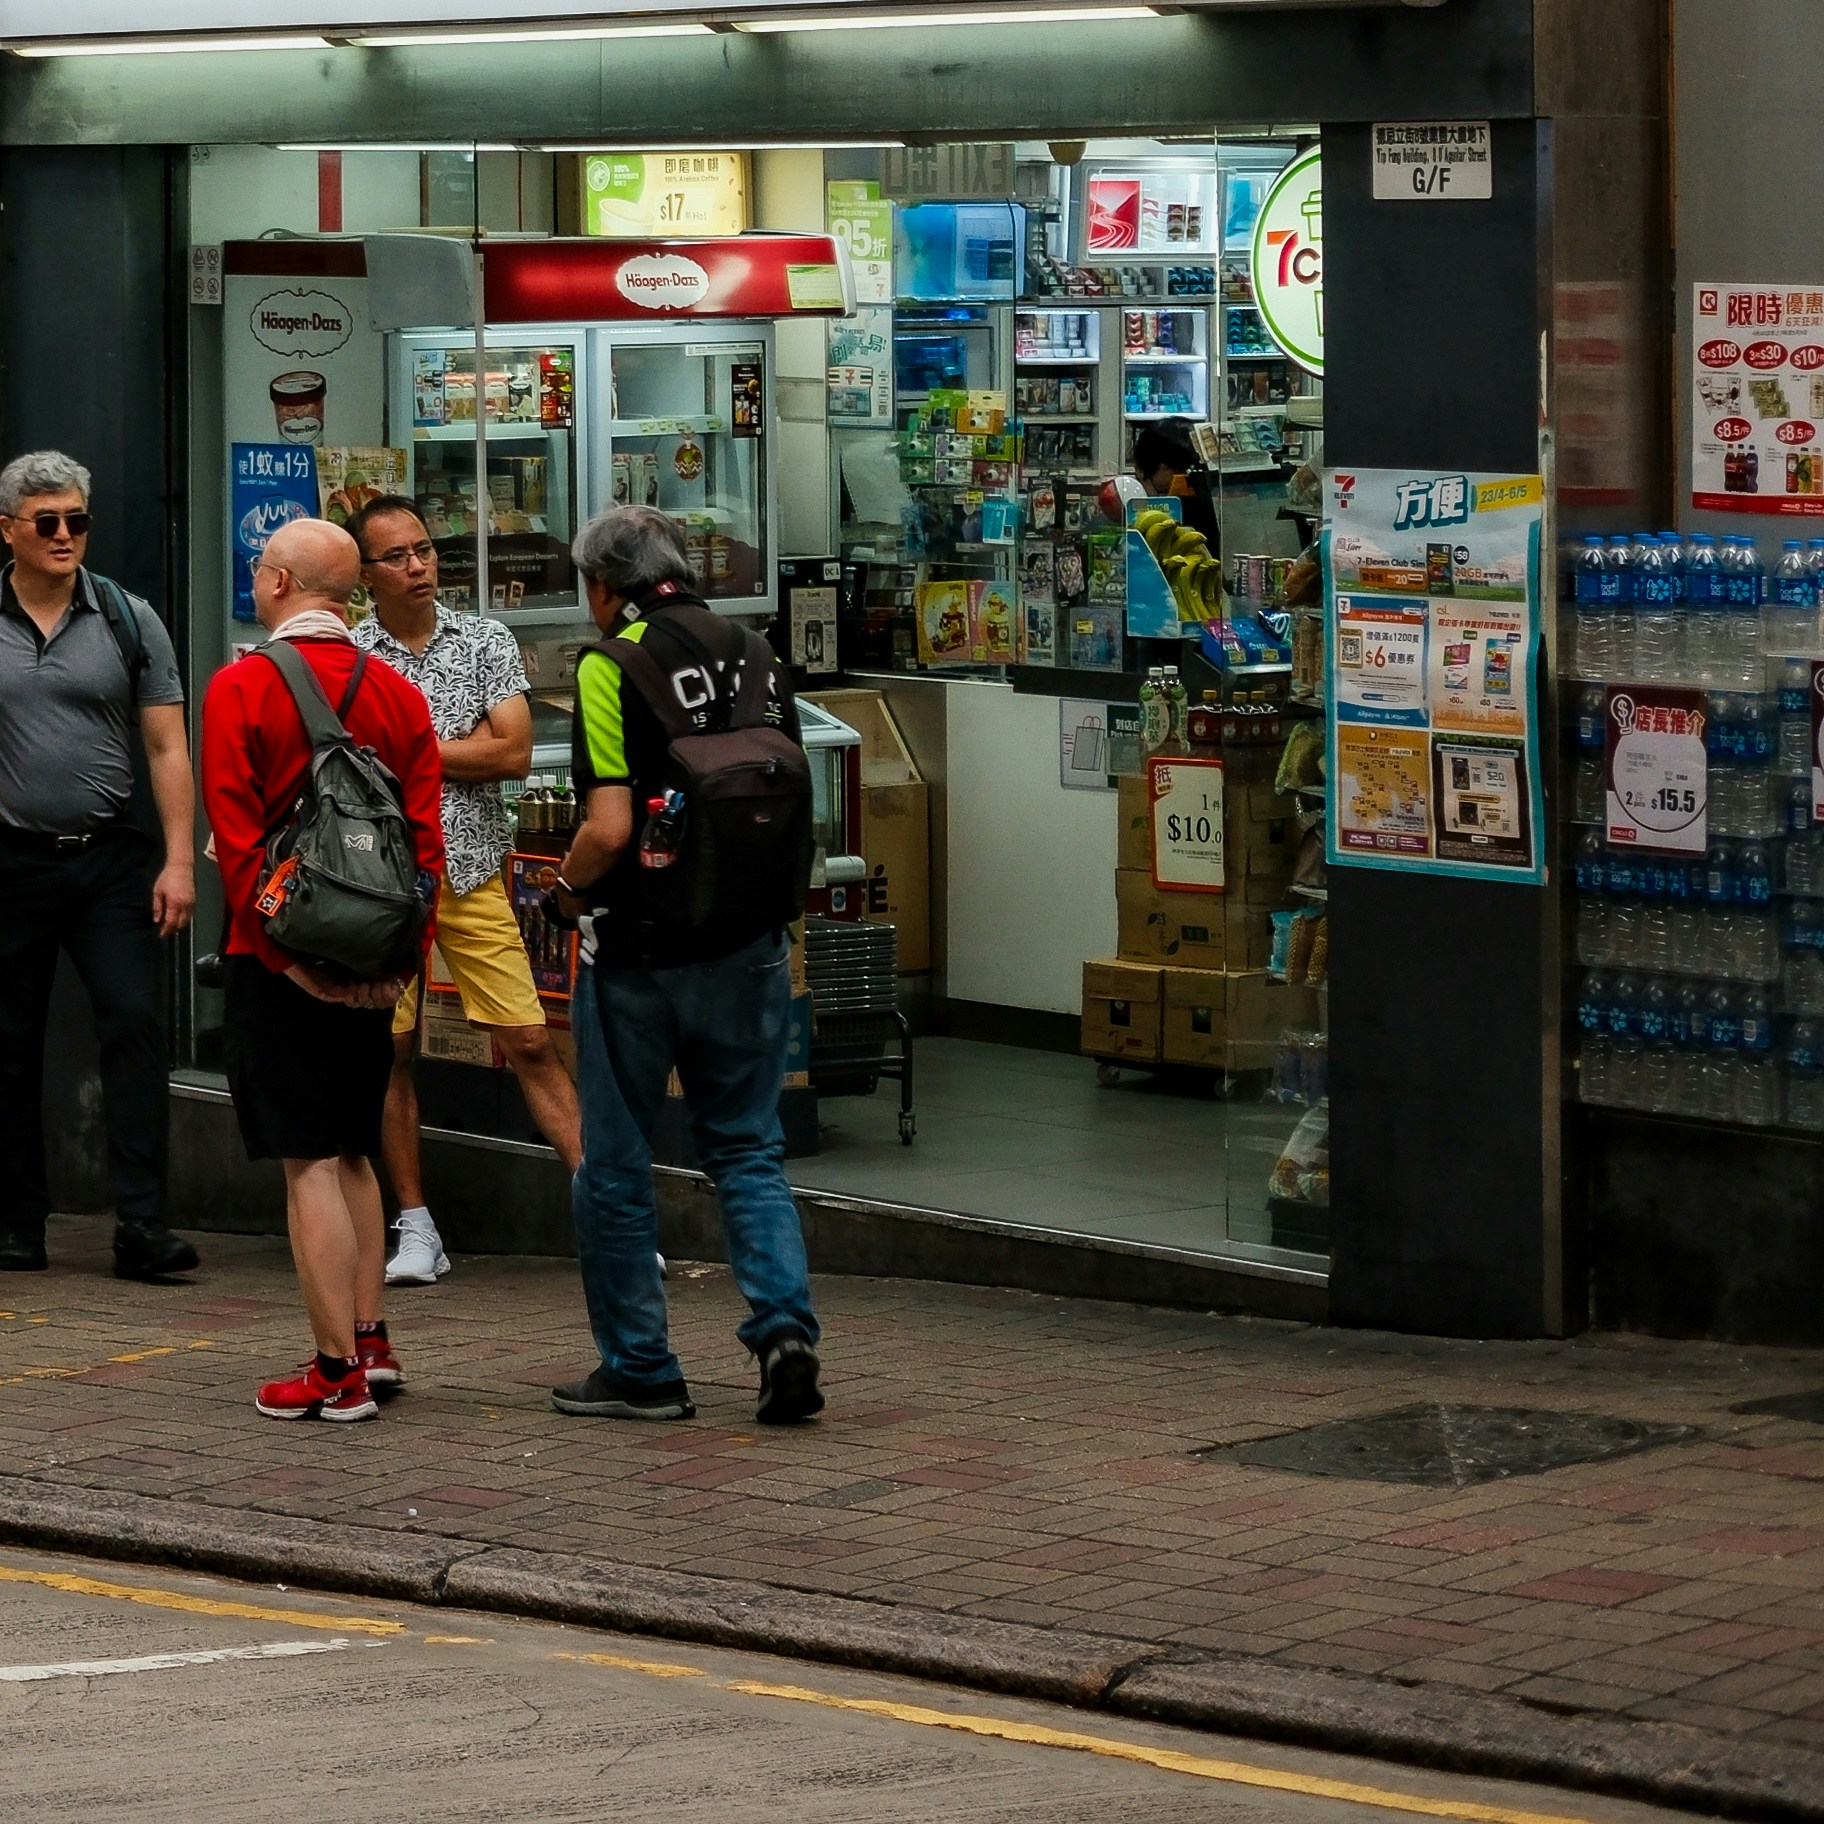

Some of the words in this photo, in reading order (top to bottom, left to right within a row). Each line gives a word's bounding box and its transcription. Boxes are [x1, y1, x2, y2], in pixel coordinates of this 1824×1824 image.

[1412, 165, 1452, 194] G/F
[660, 193, 685, 221] $17
[1394, 476, 1468, 528] 方便
[1480, 485, 1527, 504] 23/4-6/5
[1391, 557, 1408, 567] Club
[1410, 559, 1426, 568] Sim
[1454, 567, 1482, 579] 20GB
[1365, 645, 1386, 668] $6
[1635, 705, 1705, 736] 店長推介
[1155, 766, 1172, 785] 抵
[1202, 794, 1209, 811] 1
[1625, 792, 1633, 806] 2
[1651, 787, 1696, 813] $15.5
